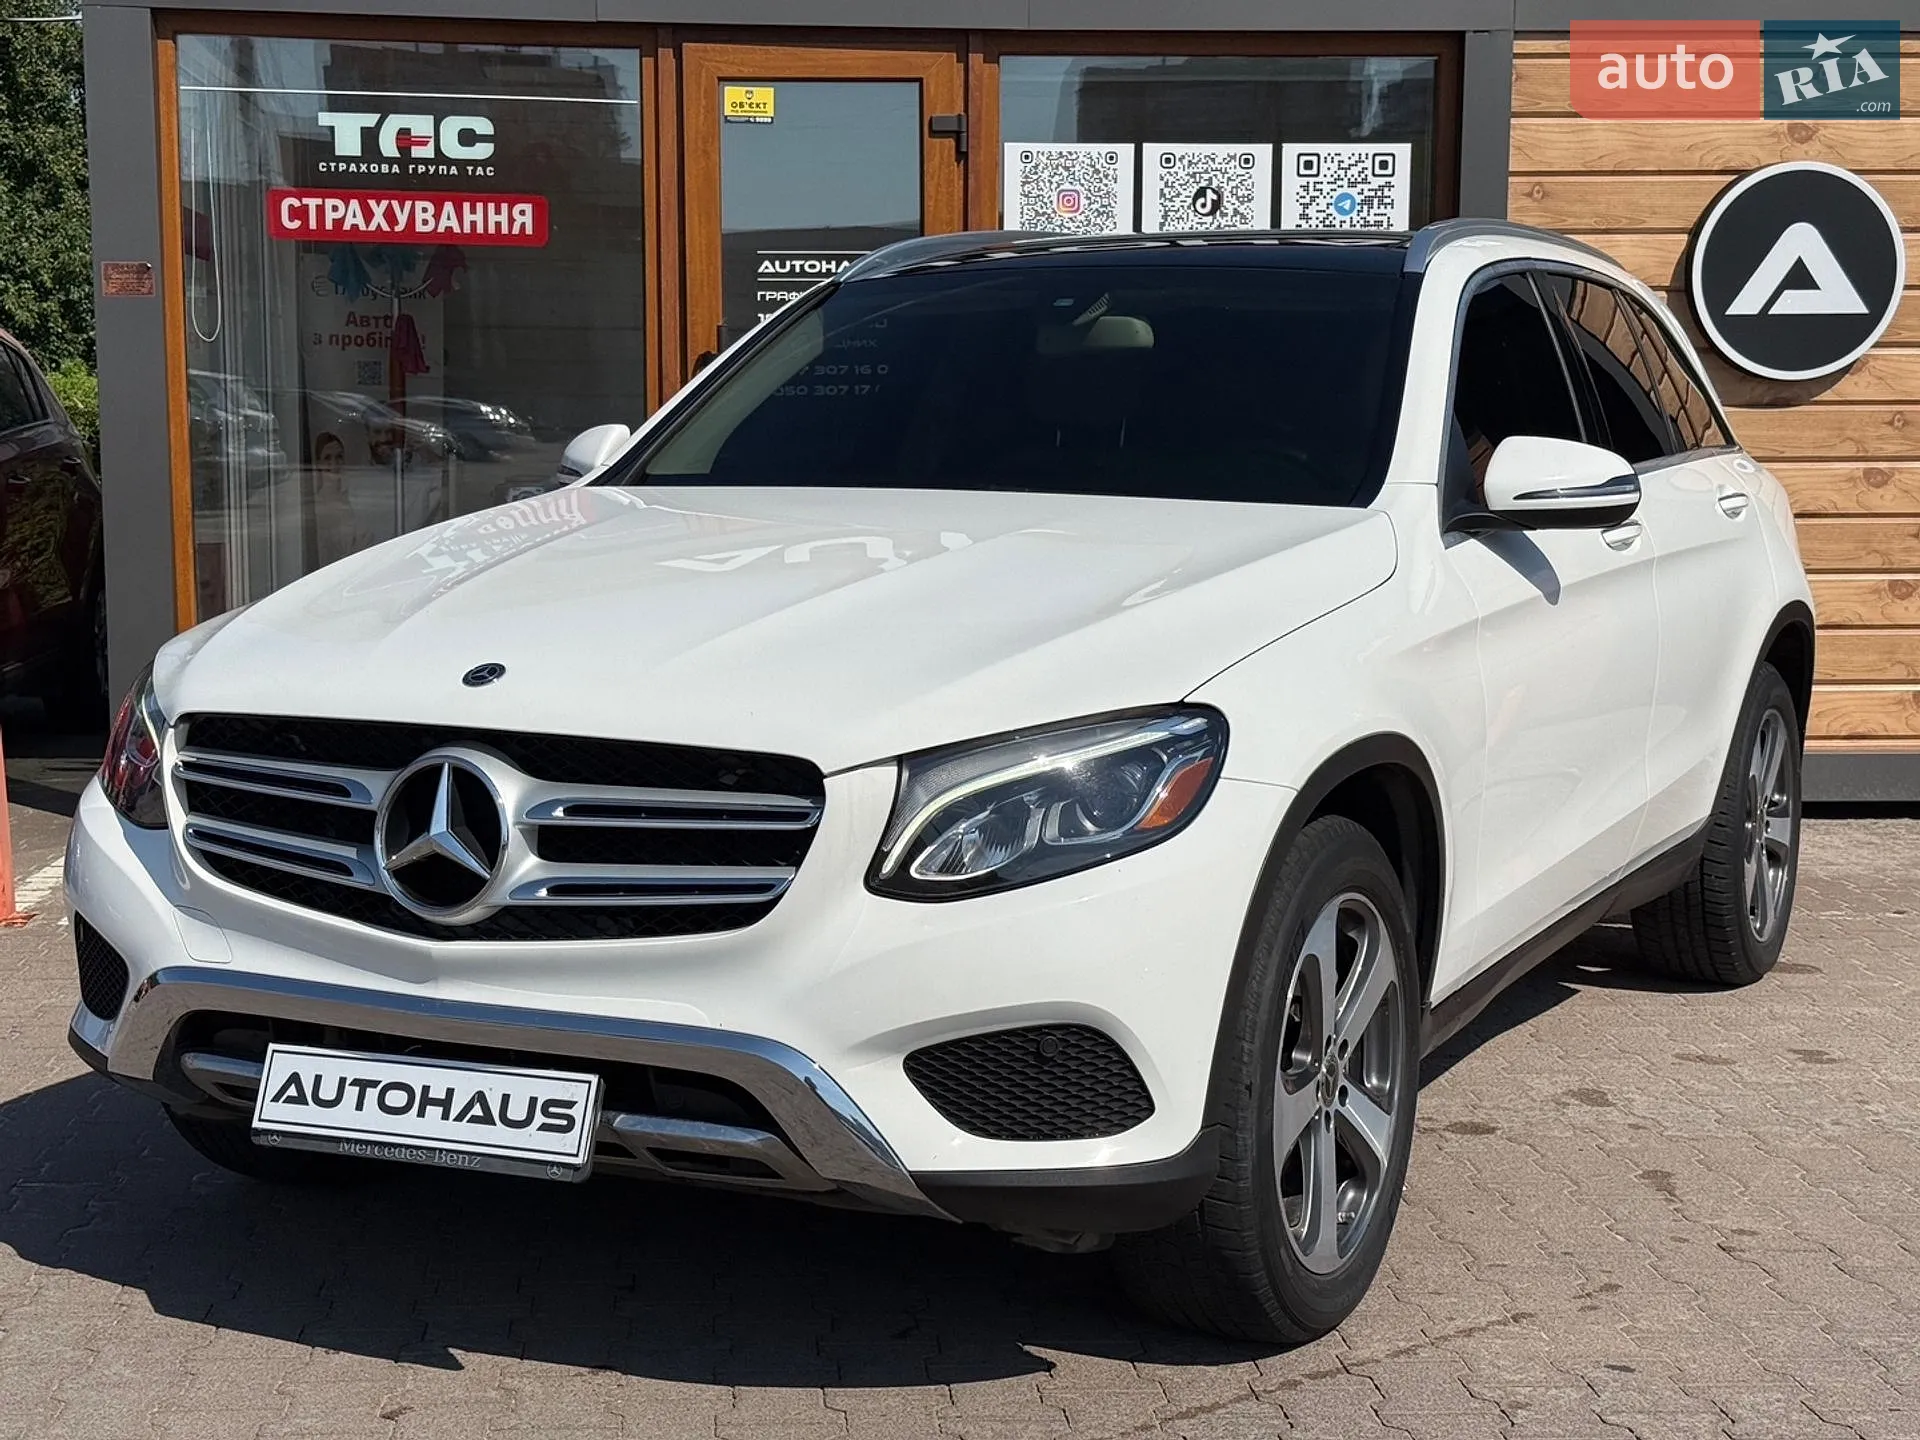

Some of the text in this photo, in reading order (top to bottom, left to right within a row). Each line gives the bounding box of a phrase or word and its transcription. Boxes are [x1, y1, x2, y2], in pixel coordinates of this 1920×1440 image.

[318, 162, 495, 176] СТРАХОВА ГРУПА ТАС
[280, 196, 534, 235] СТРАХУВАННЯ
[757, 260, 850, 273] AUTOHA
[269, 1071, 579, 1134] AUTOHAUS
[339, 1139, 481, 1168] Mercedes-Benz
